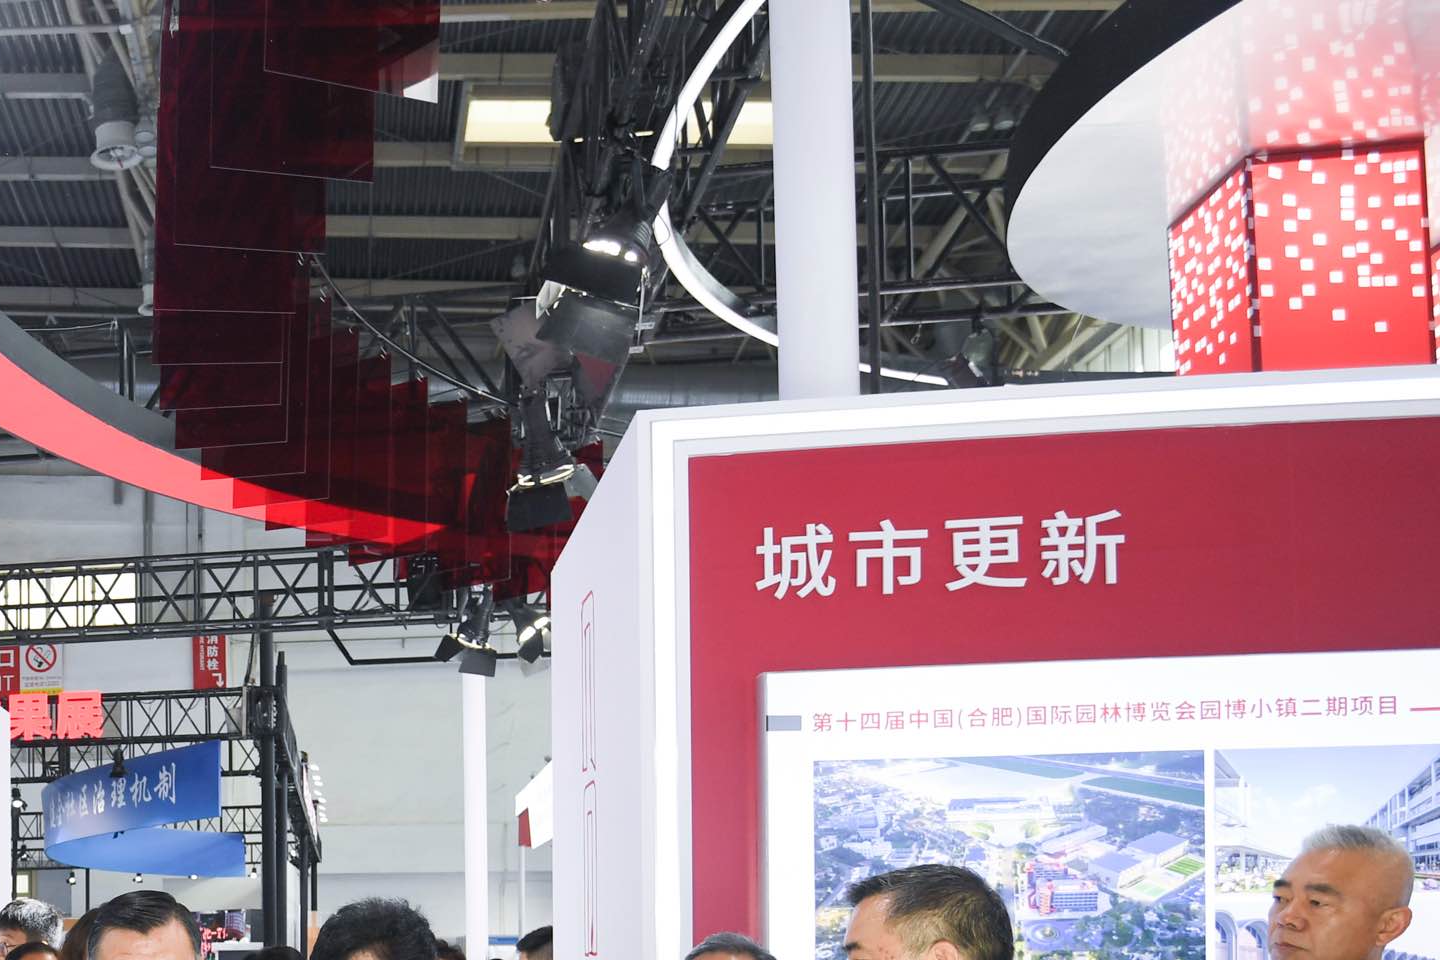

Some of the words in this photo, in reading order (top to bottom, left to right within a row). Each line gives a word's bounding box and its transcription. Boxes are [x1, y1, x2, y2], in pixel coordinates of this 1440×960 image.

[755, 508, 1125, 600] 城市更新
[812, 695, 1398, 733] 第十四届中国(合肥)国际园林博览会园博小镇二期项目
